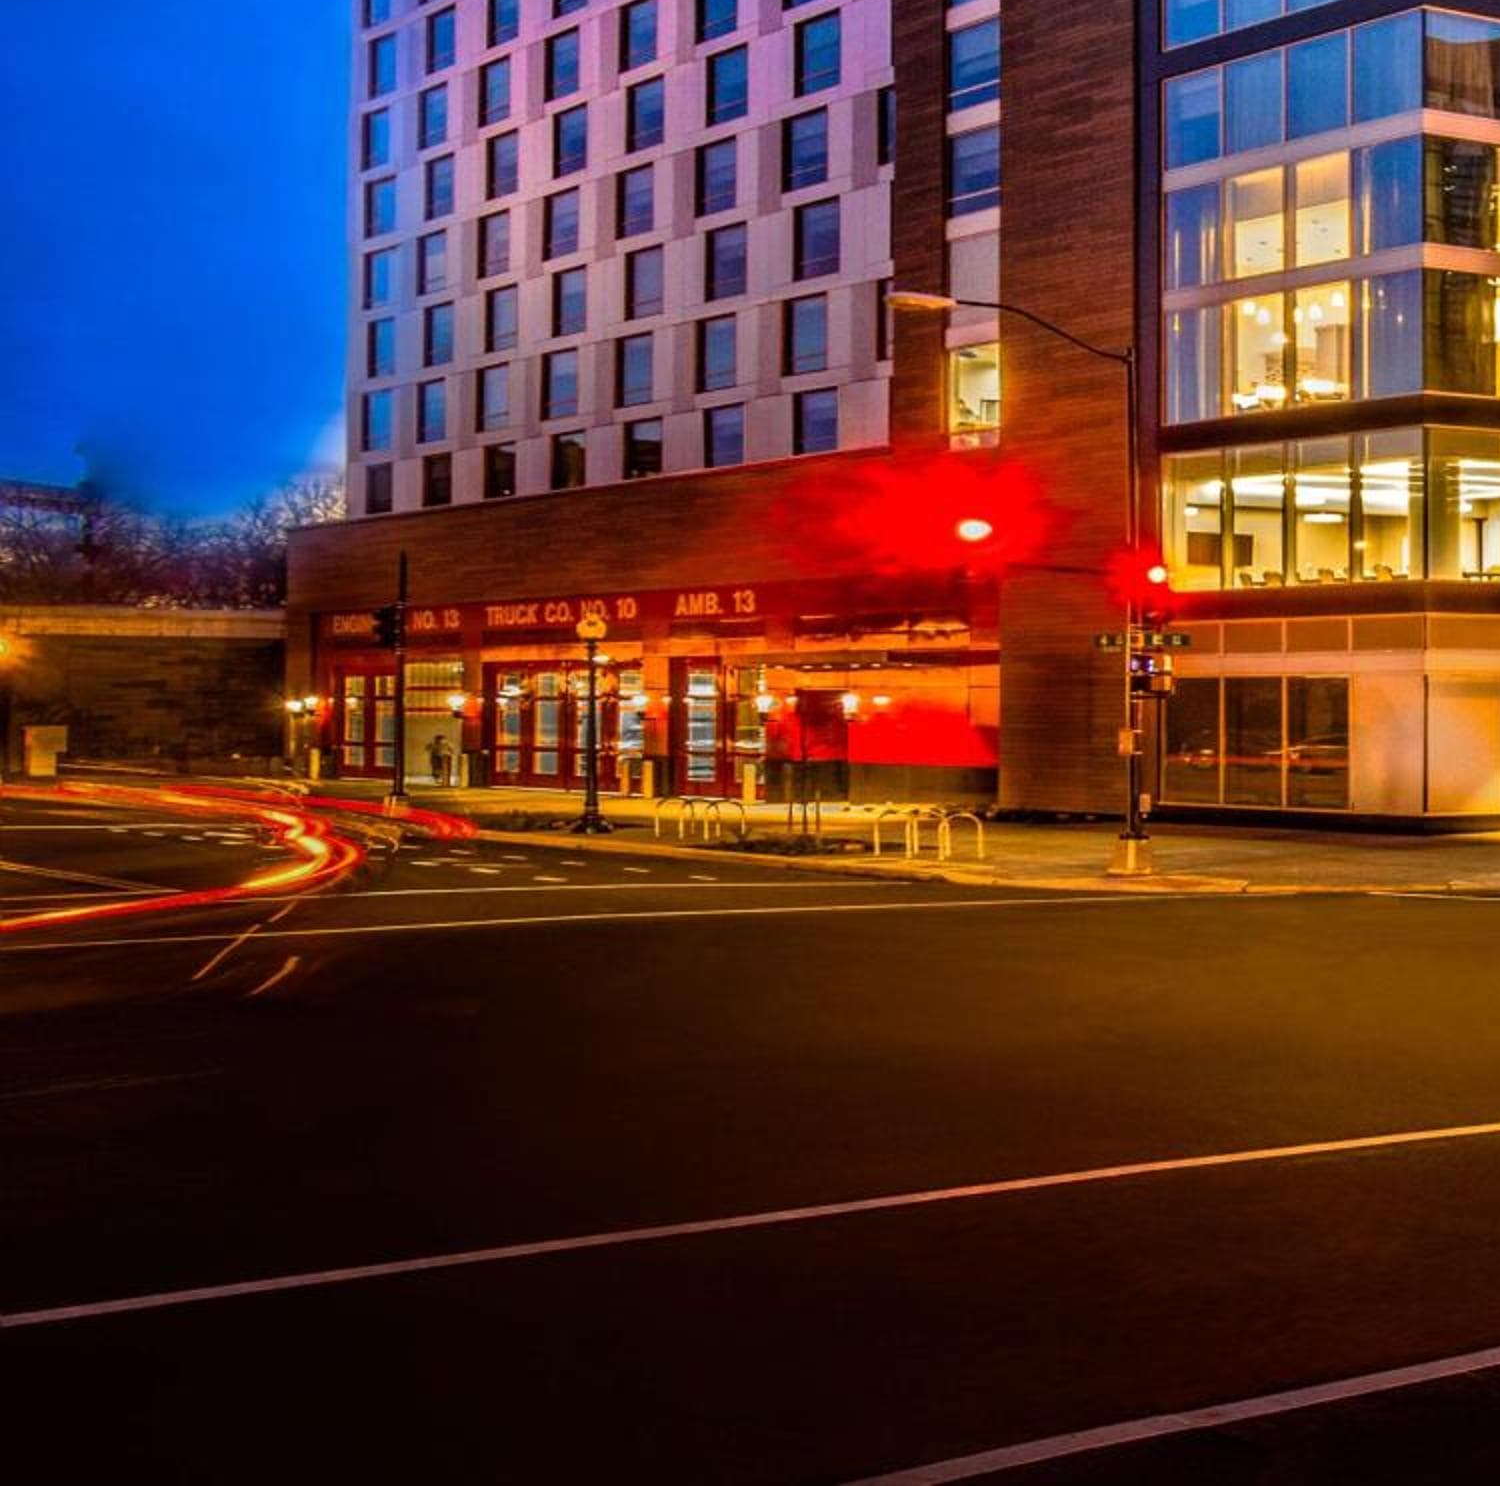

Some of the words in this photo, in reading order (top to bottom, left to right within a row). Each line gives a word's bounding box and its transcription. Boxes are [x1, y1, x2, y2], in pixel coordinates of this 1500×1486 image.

[485, 603, 538, 626] TRUCK
[544, 601, 574, 623] CO.
[616, 597, 637, 619] 10
[674, 591, 724, 616] AMB.
[733, 589, 756, 613] 13
[413, 610, 439, 630] NO.
[443, 609, 460, 629] 13
